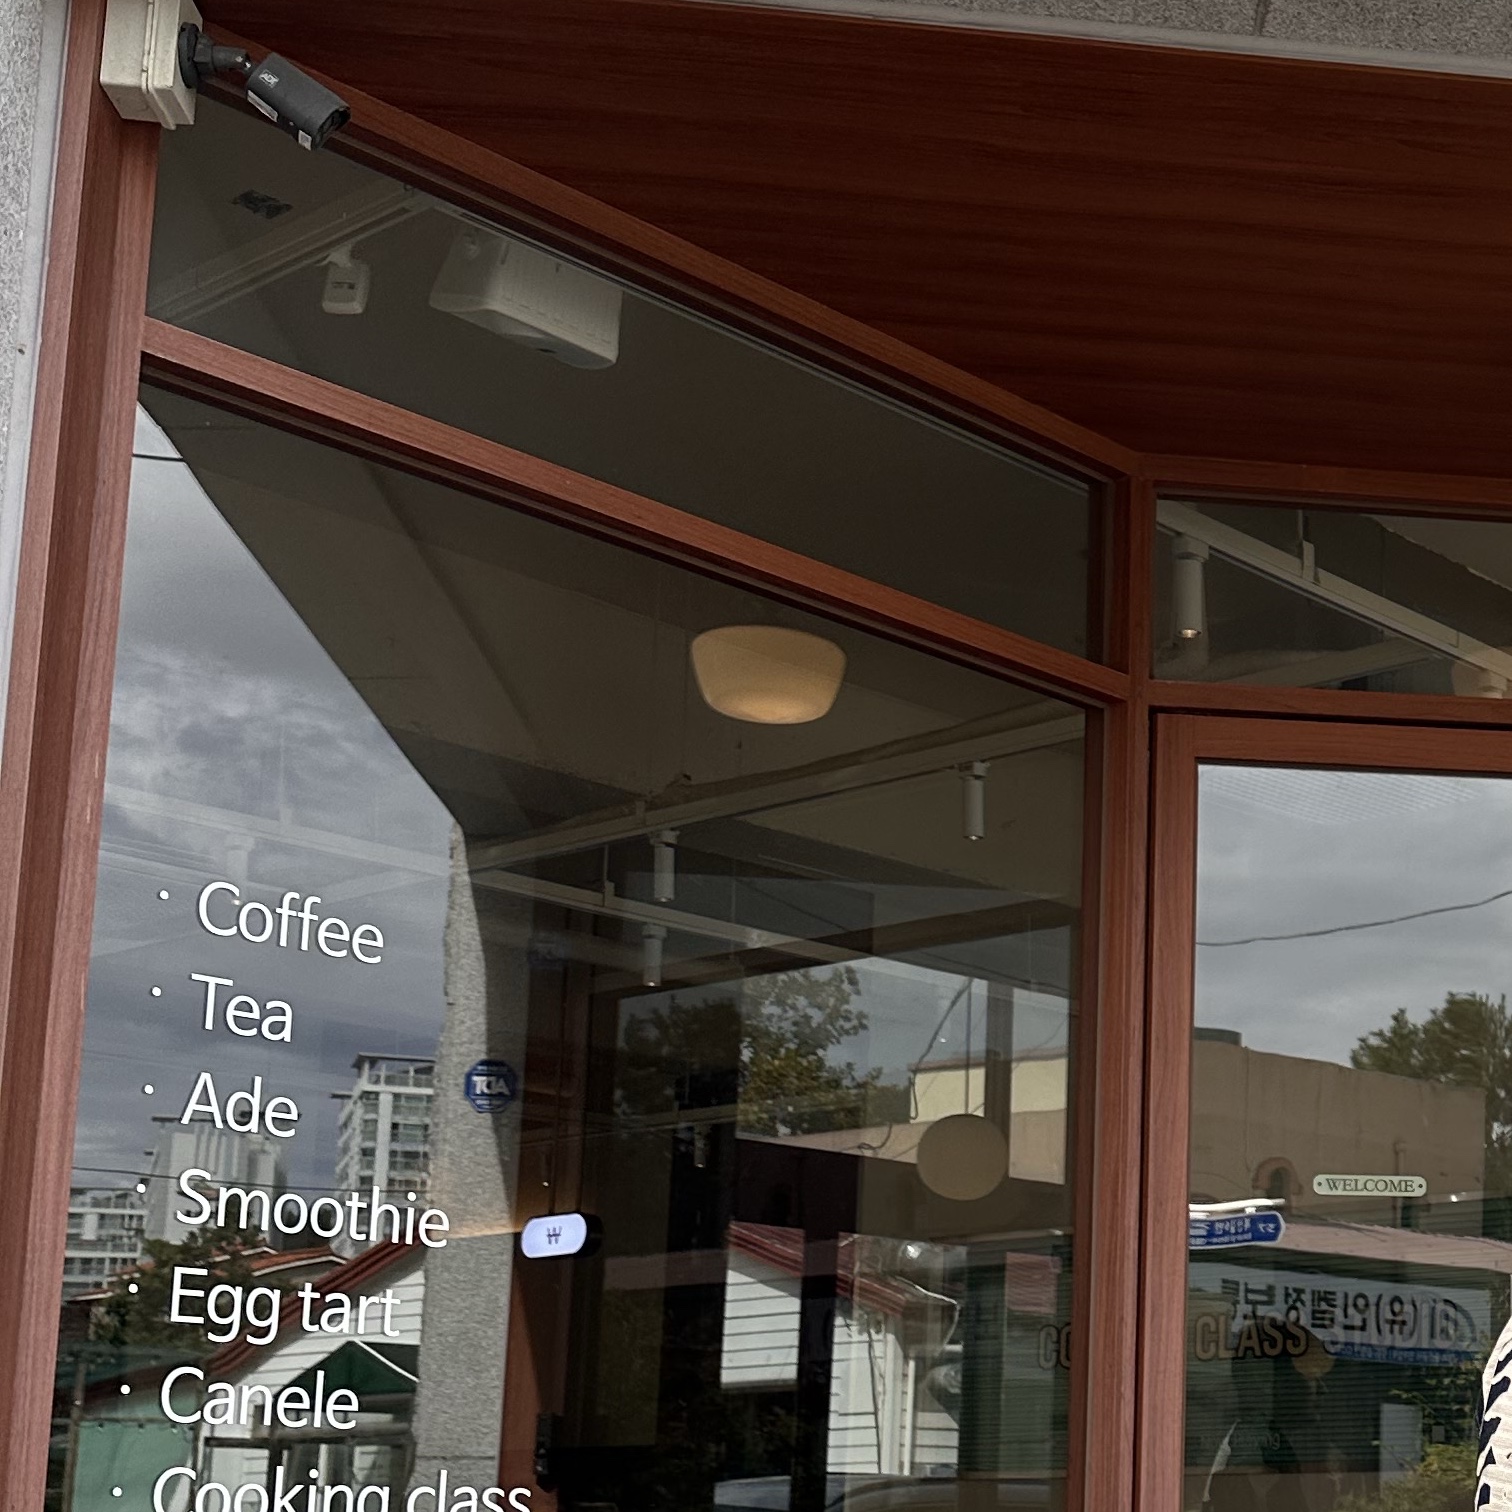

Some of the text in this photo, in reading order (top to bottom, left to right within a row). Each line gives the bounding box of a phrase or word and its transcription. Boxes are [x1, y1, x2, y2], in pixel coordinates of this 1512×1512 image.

[198, 881, 385, 966] Coffee
[190, 973, 294, 1043] Tea
[180, 1072, 301, 1139] Ade
[175, 1167, 451, 1250] Smoothie
[1326, 1177, 1416, 1195] WELCOME
[169, 1266, 402, 1346] Egg tart
[1195, 1312, 1310, 1362] CLASS
[160, 1365, 361, 1432] Canele
